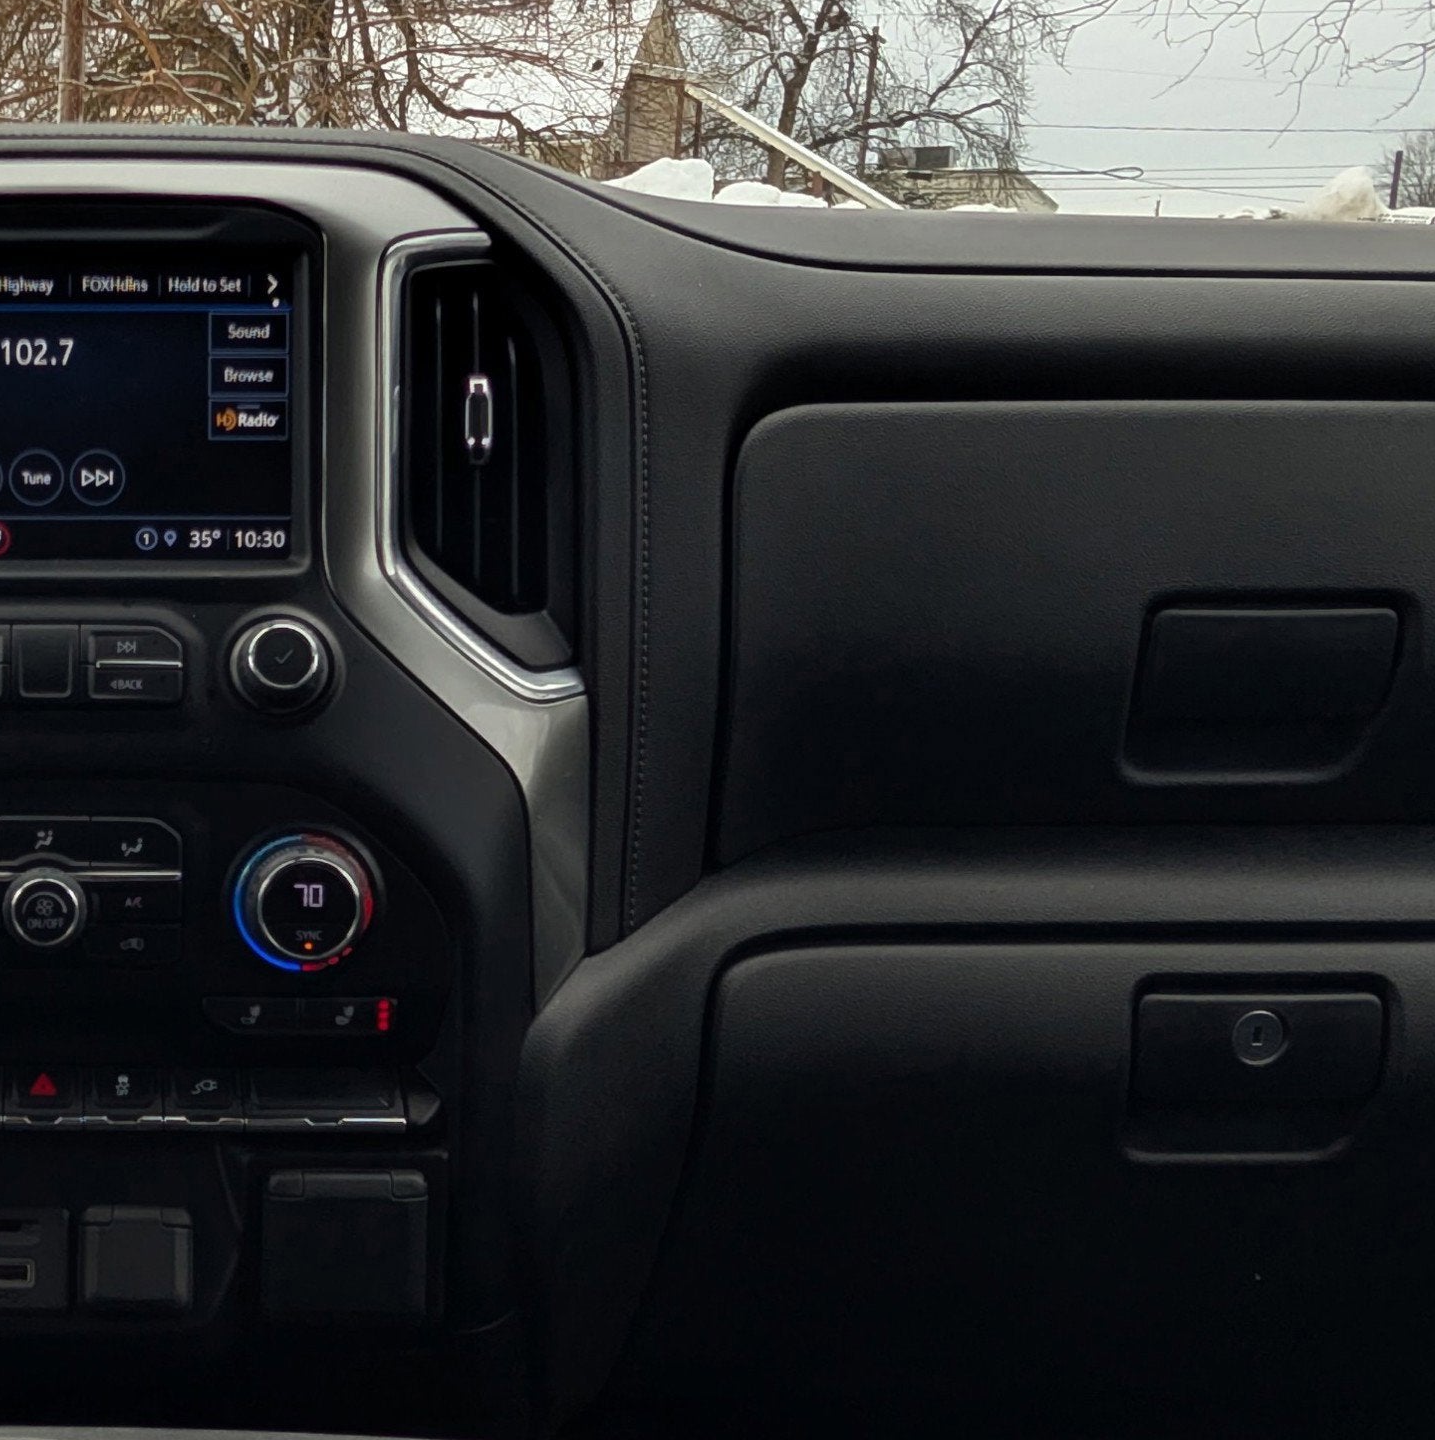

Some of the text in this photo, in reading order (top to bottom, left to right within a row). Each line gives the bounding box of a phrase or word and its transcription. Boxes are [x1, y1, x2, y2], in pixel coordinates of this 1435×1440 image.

[168, 275, 242, 292] Hold to Set
[228, 323, 271, 339] Sound
[1, 337, 75, 366] 102.7
[224, 366, 274, 383] Browse
[237, 411, 280, 428] Radio
[21, 470, 52, 486] Tune
[234, 529, 286, 549] 10:30
[293, 884, 324, 908] 70
[26, 916, 65, 931] ON/OFF
[294, 930, 324, 942] SYNC
